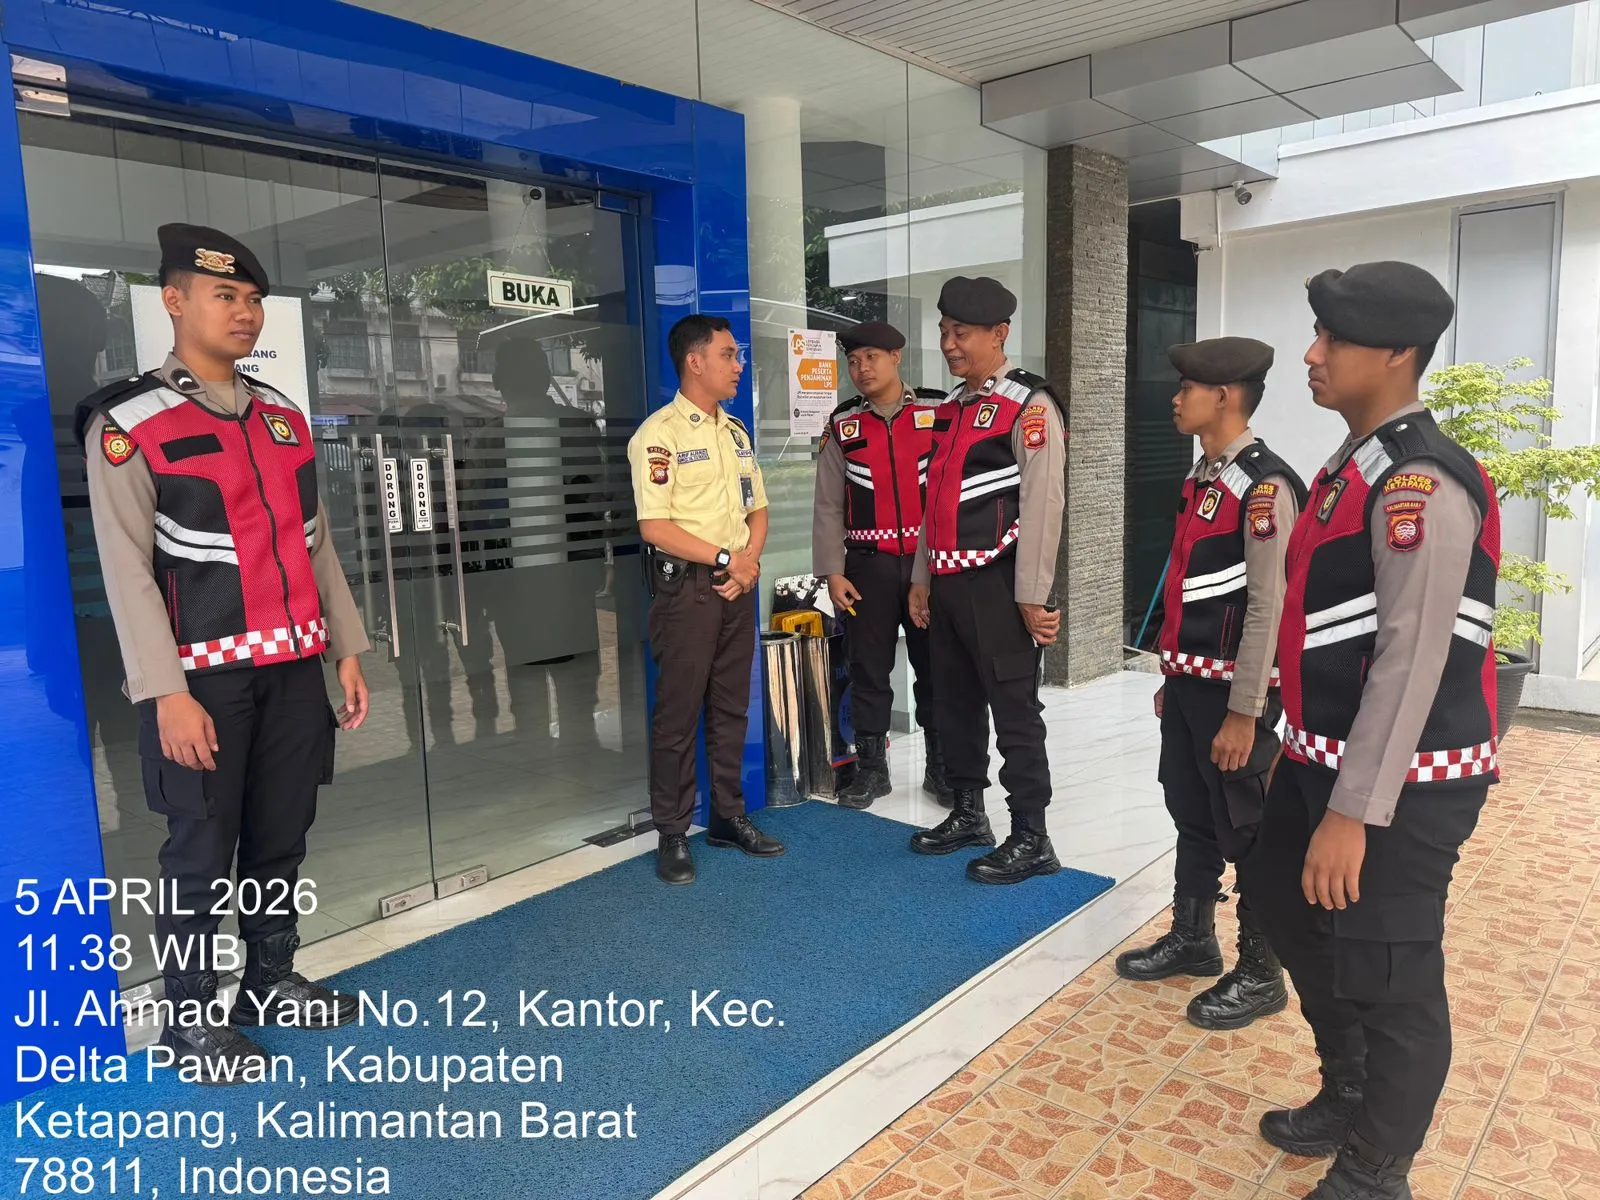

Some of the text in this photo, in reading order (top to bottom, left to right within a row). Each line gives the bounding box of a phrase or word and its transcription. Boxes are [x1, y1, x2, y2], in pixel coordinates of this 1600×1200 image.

[502, 281, 560, 307] BUKA
[385, 464, 396, 518] DORONG
[416, 464, 427, 517] DORONG
[1384, 480, 1432, 492] KETAPANG
[1386, 475, 1432, 485] POLRES
